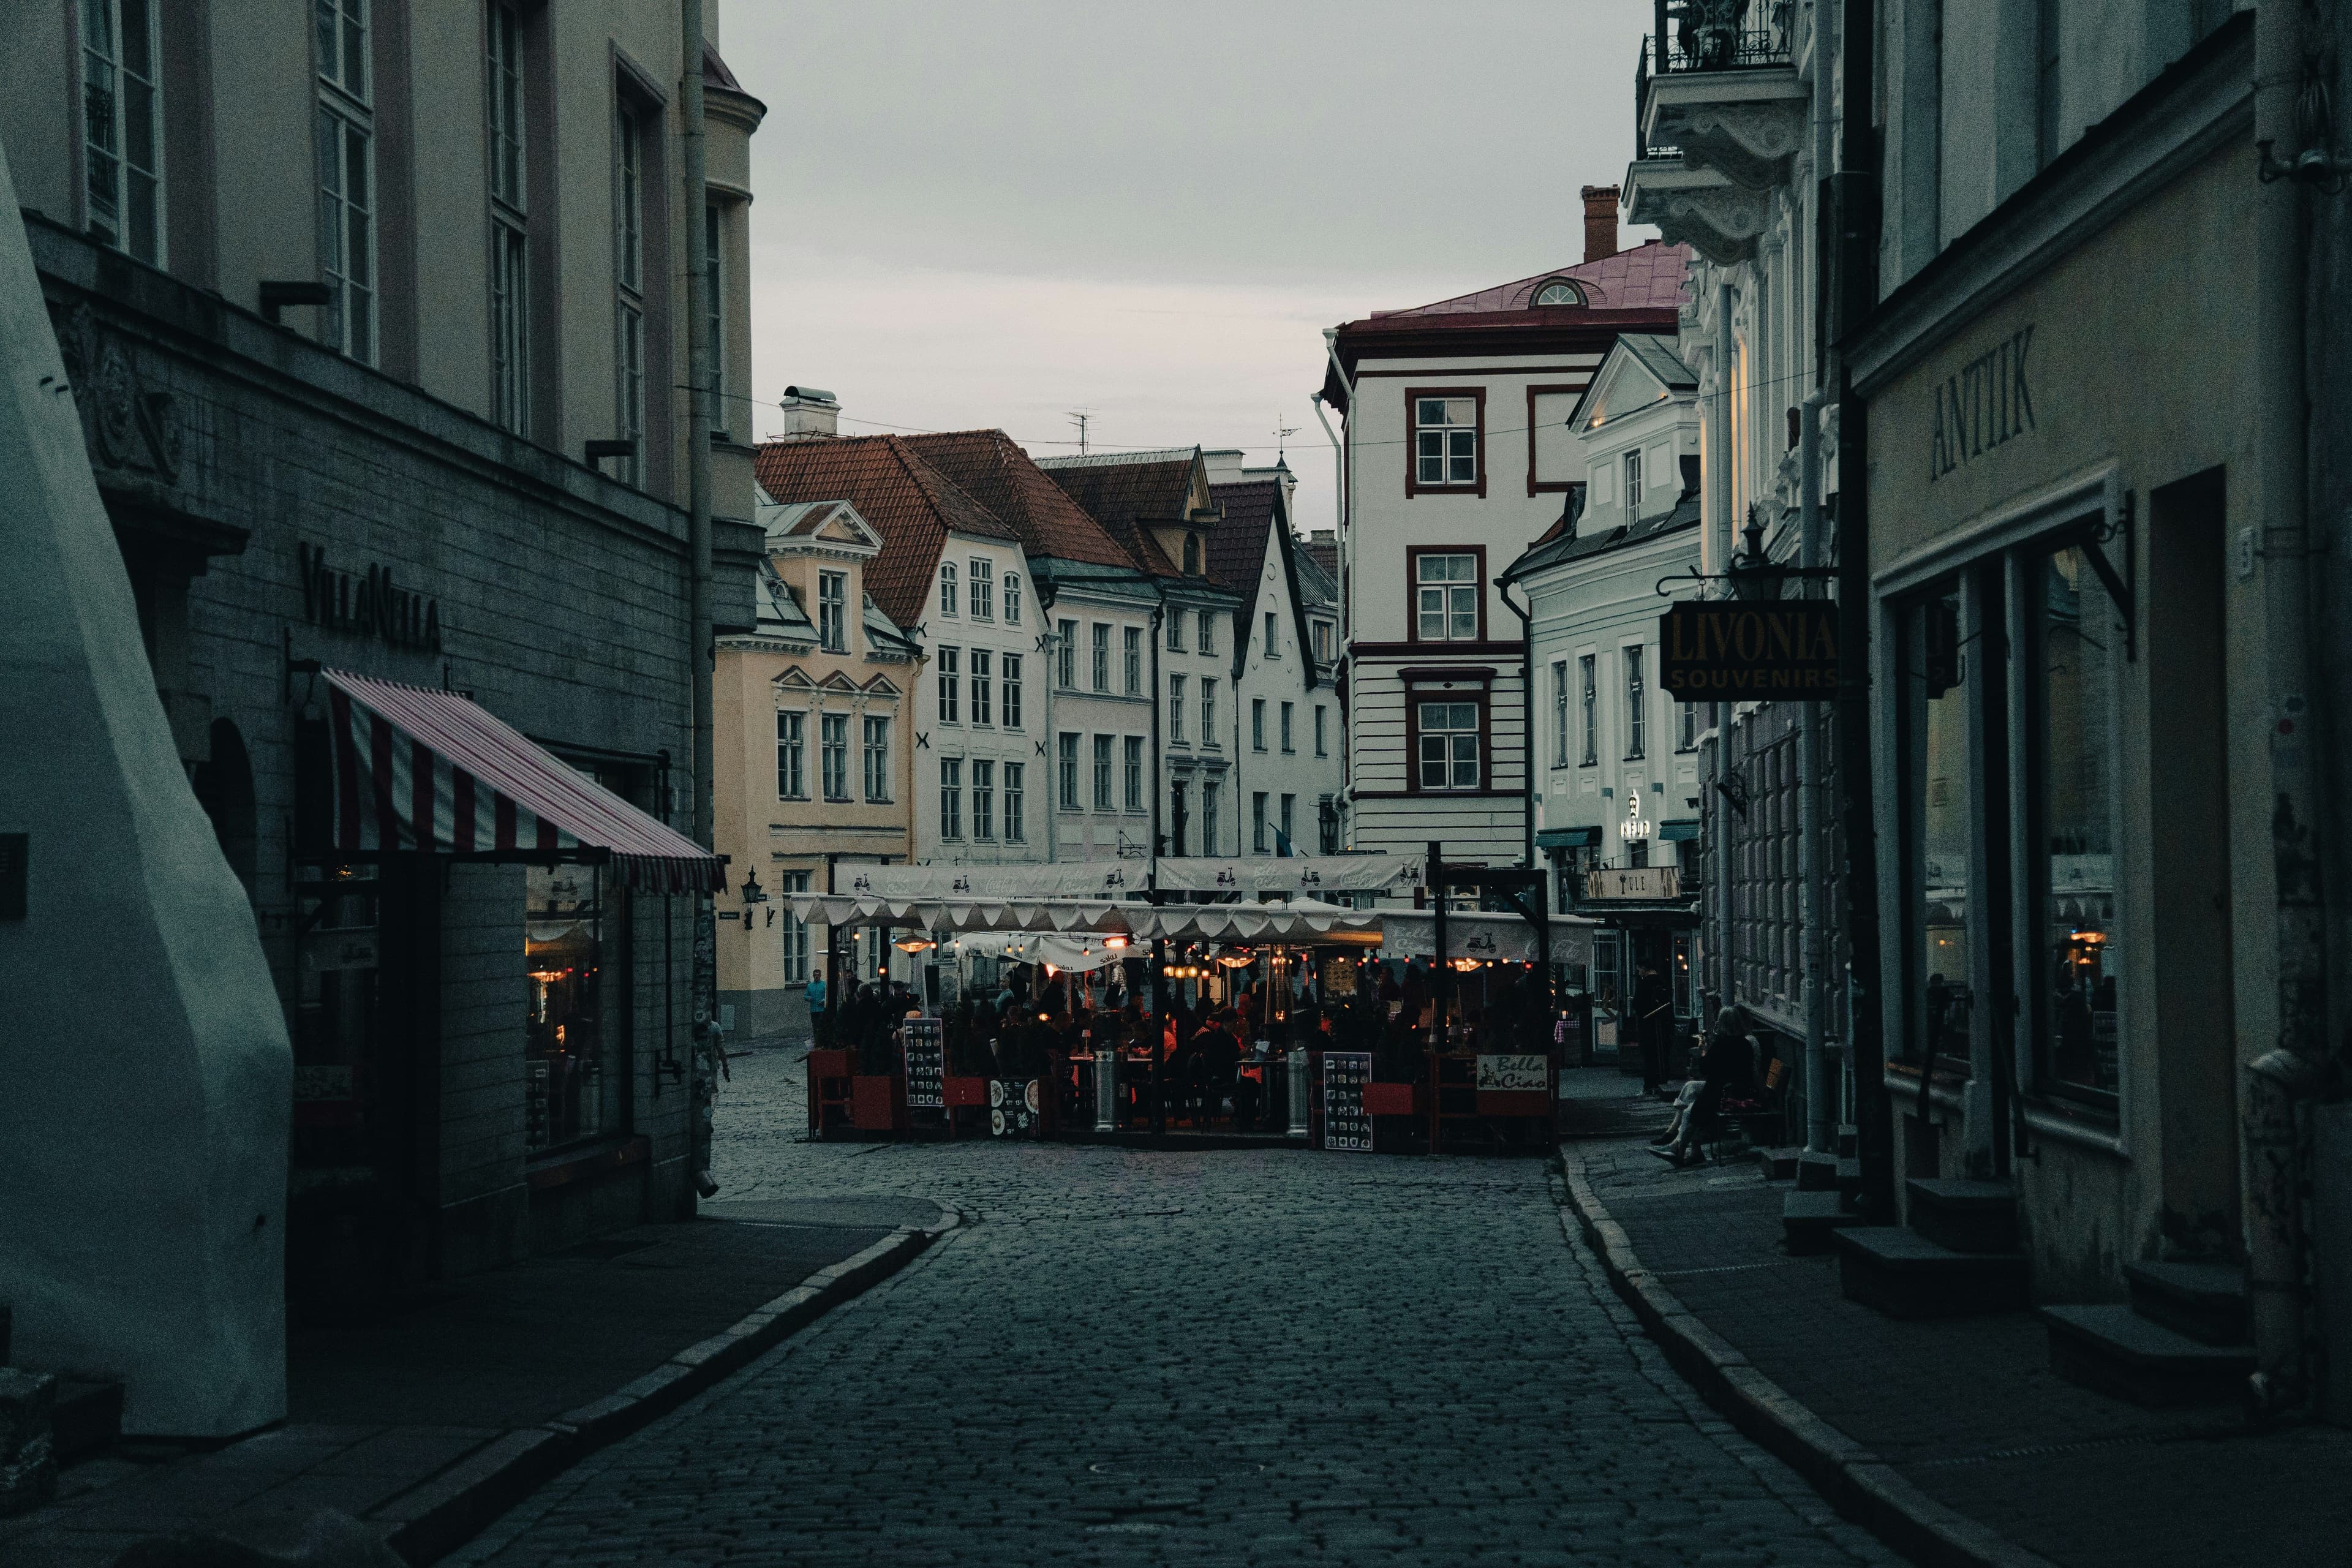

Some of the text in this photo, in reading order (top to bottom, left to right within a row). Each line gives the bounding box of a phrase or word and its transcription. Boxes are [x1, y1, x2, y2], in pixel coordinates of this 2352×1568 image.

[1930, 322, 2035, 484] ANTIIK
[1670, 611, 1838, 662] LIVONIA
[1670, 668, 1838, 688] SOUVENIRS
[1100, 953, 1118, 964] saku
[1497, 1057, 1545, 1072] Bella
[1501, 1073, 1545, 1088] Ciao
